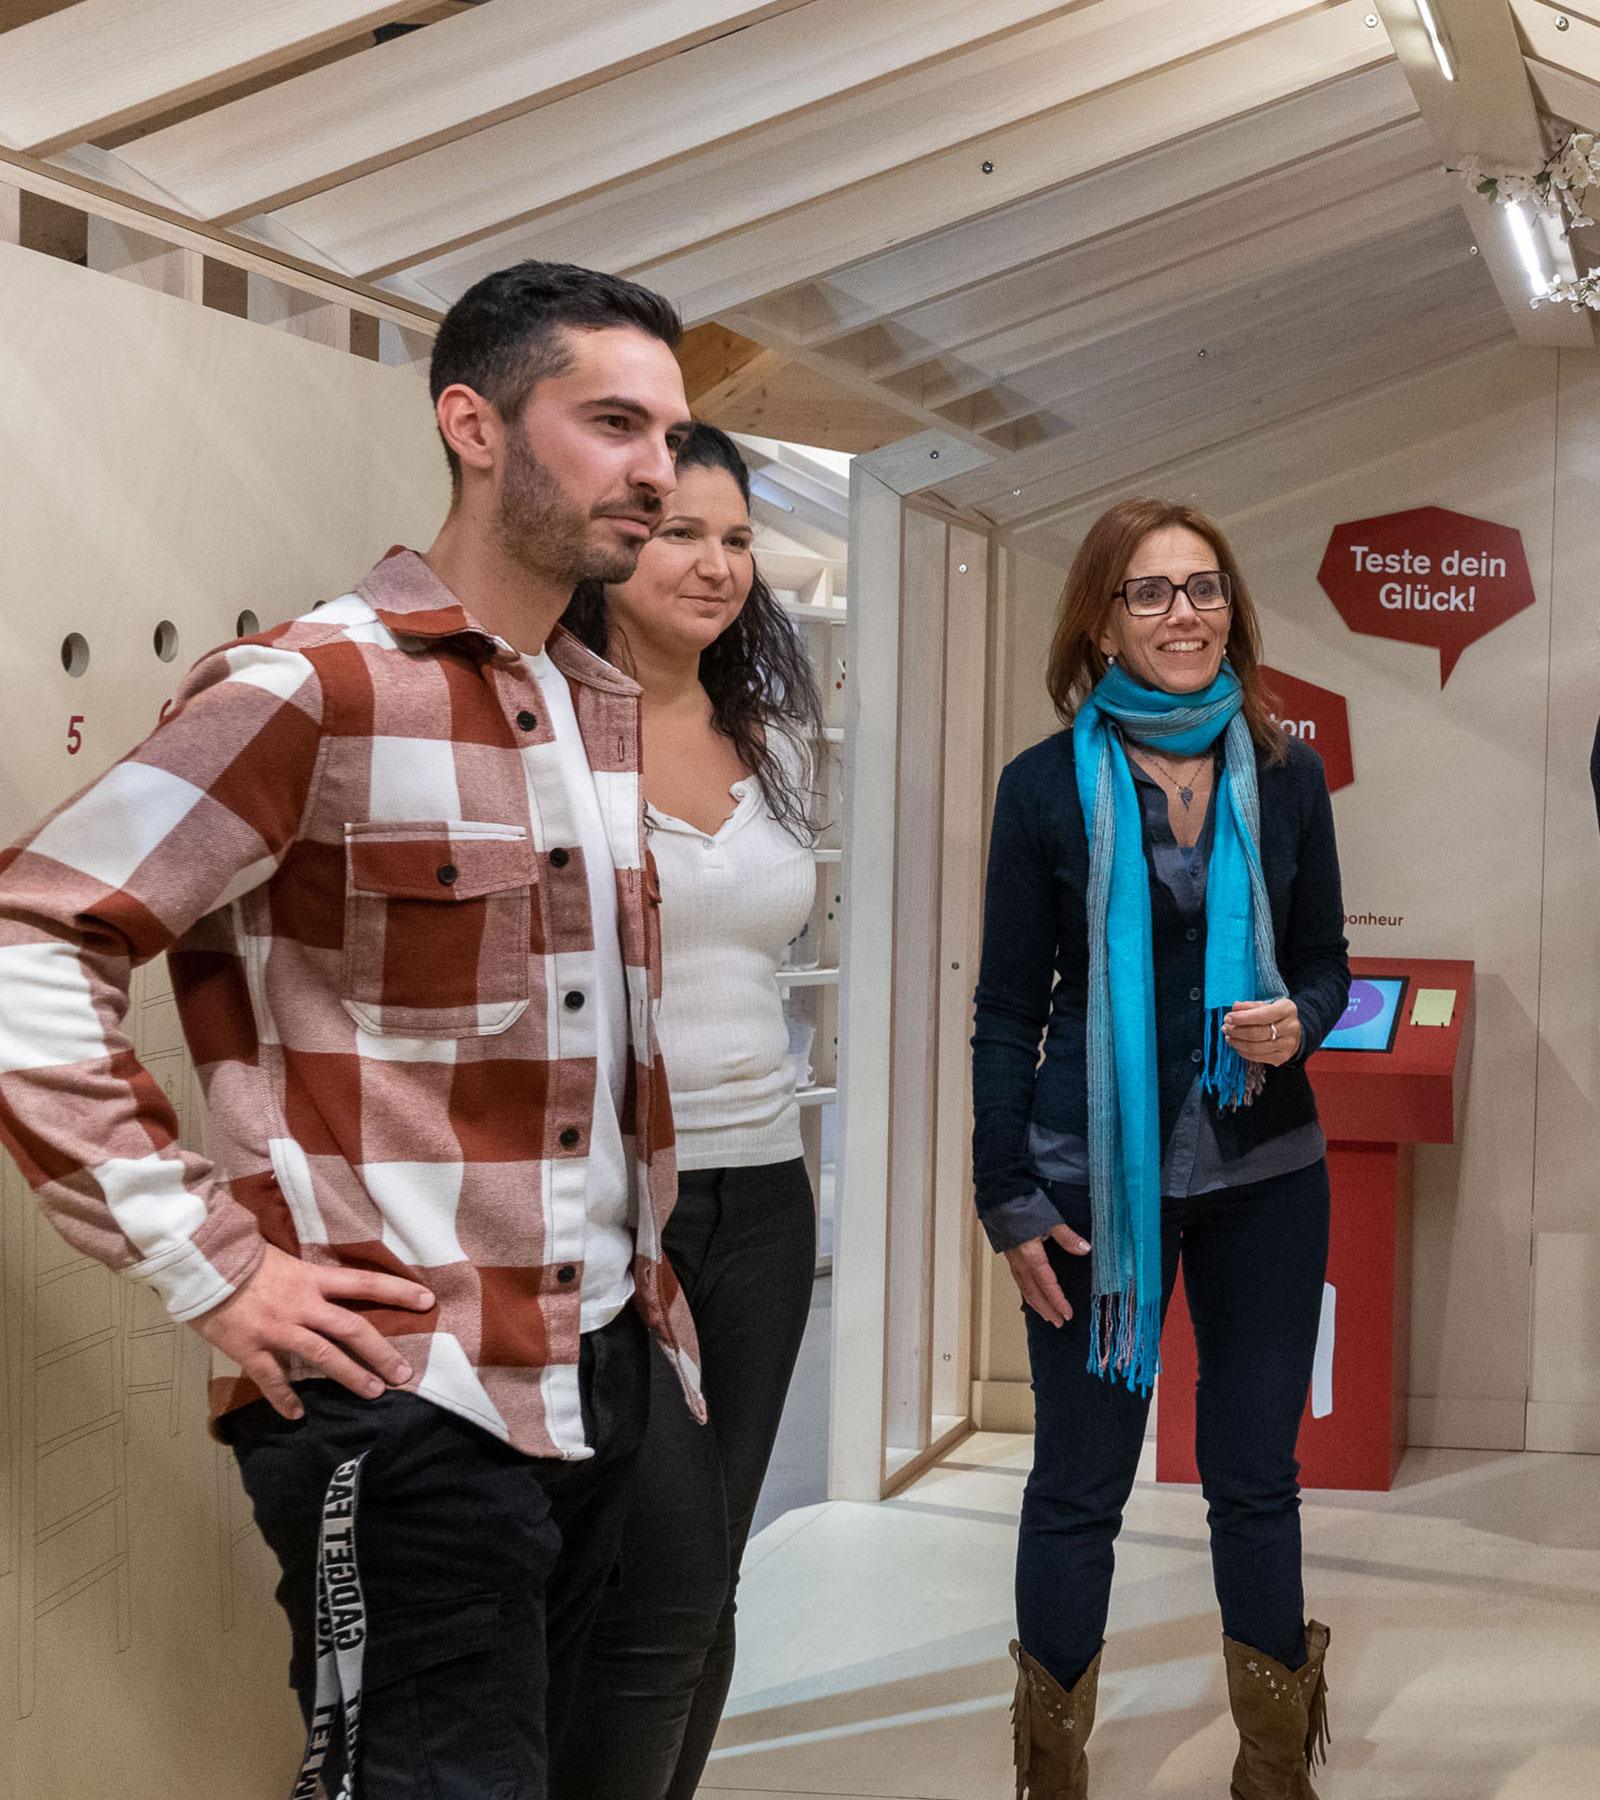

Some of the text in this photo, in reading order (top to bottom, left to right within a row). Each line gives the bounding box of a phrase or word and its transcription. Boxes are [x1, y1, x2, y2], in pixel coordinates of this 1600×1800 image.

[1350, 546, 1506, 578] Teste dein
[1379, 582, 1476, 613] Glück!
[67, 715, 84, 755] 5
